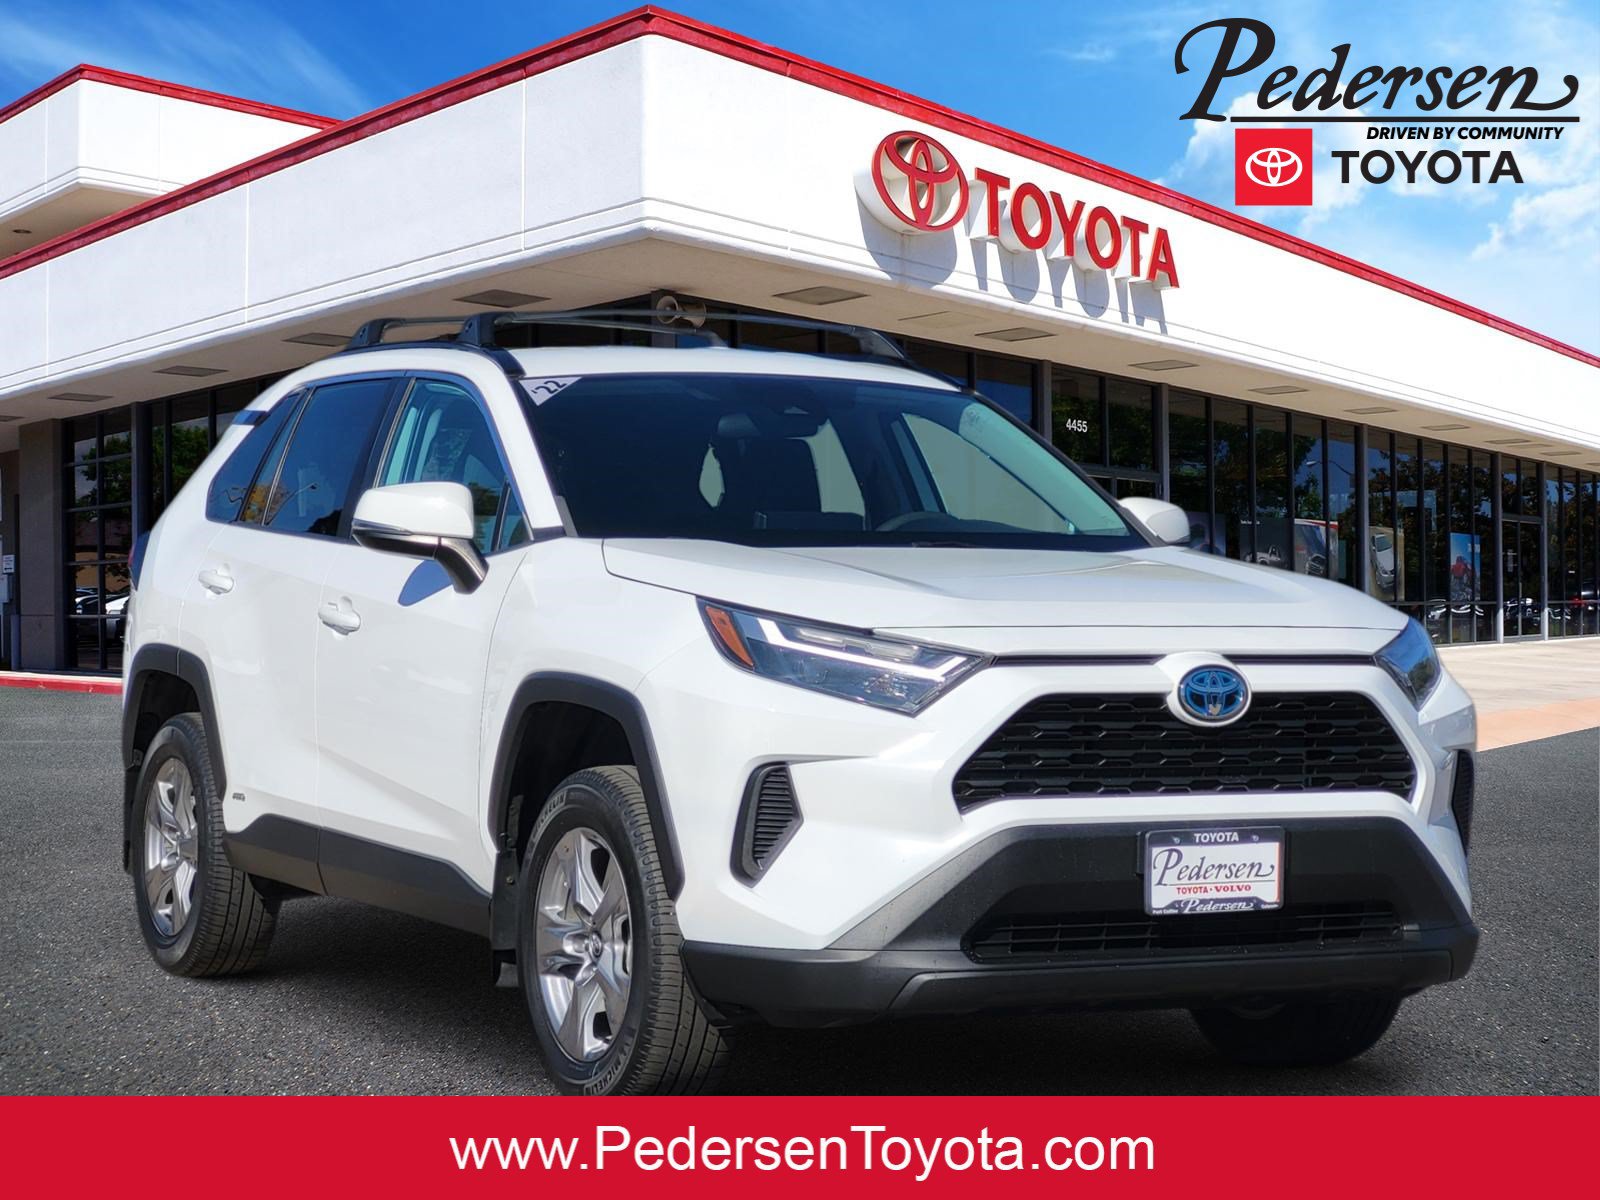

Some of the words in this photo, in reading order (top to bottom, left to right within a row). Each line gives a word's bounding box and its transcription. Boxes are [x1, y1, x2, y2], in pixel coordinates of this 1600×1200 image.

[974, 167, 1180, 288] TOYOTA
[1066, 418, 1088, 433] 4455
[1193, 832, 1240, 844] TOYOTA
[1153, 848, 1276, 887] Pedersen
[1176, 886, 1209, 895] TOYOTA
[1214, 884, 1252, 893] VOLVO
[1180, 899, 1255, 914] Pedersen
